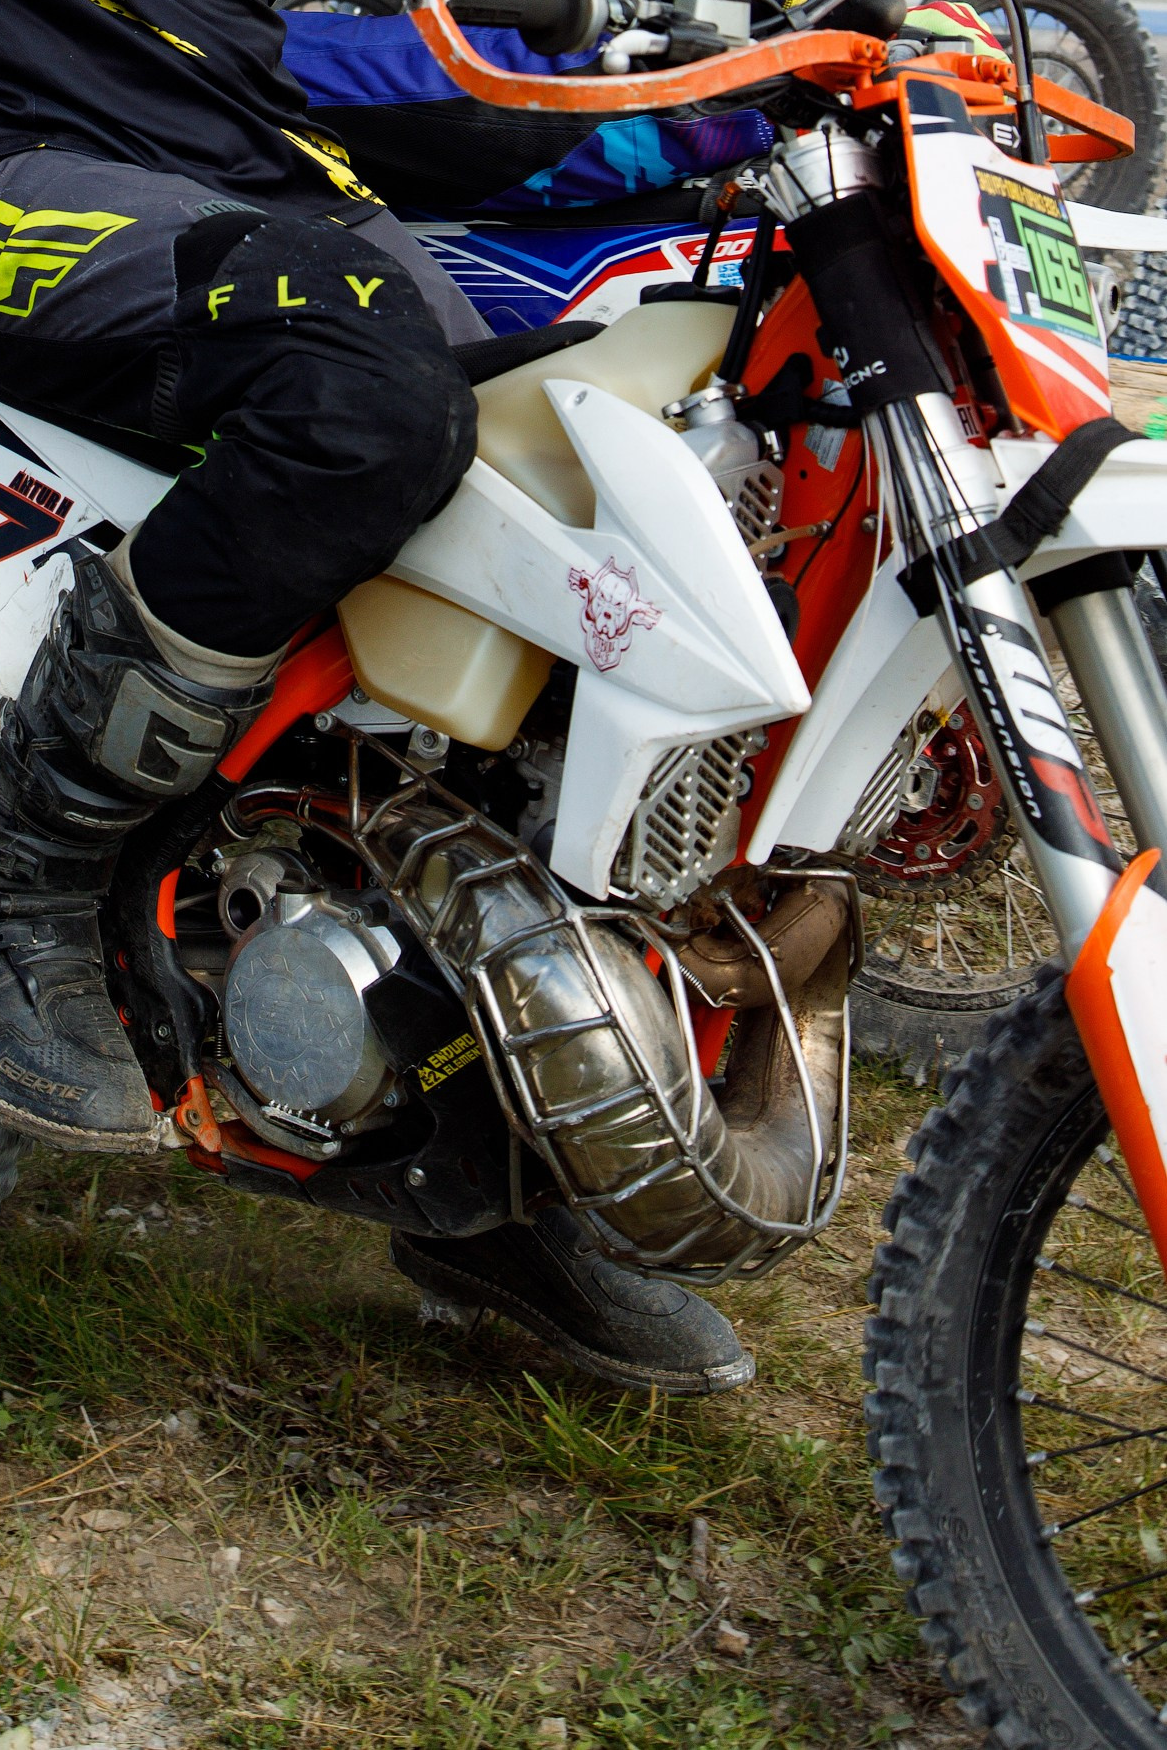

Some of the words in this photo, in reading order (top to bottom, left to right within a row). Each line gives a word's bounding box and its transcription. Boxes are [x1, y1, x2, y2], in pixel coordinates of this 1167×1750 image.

[688, 238, 754, 261] 300
[1023, 225, 1092, 316] 166
[207, 274, 386, 321] FLY
[8, 468, 63, 513] ARTUR
[957, 624, 1043, 820] SUSPENSION
[426, 1032, 477, 1070] ENDURO
